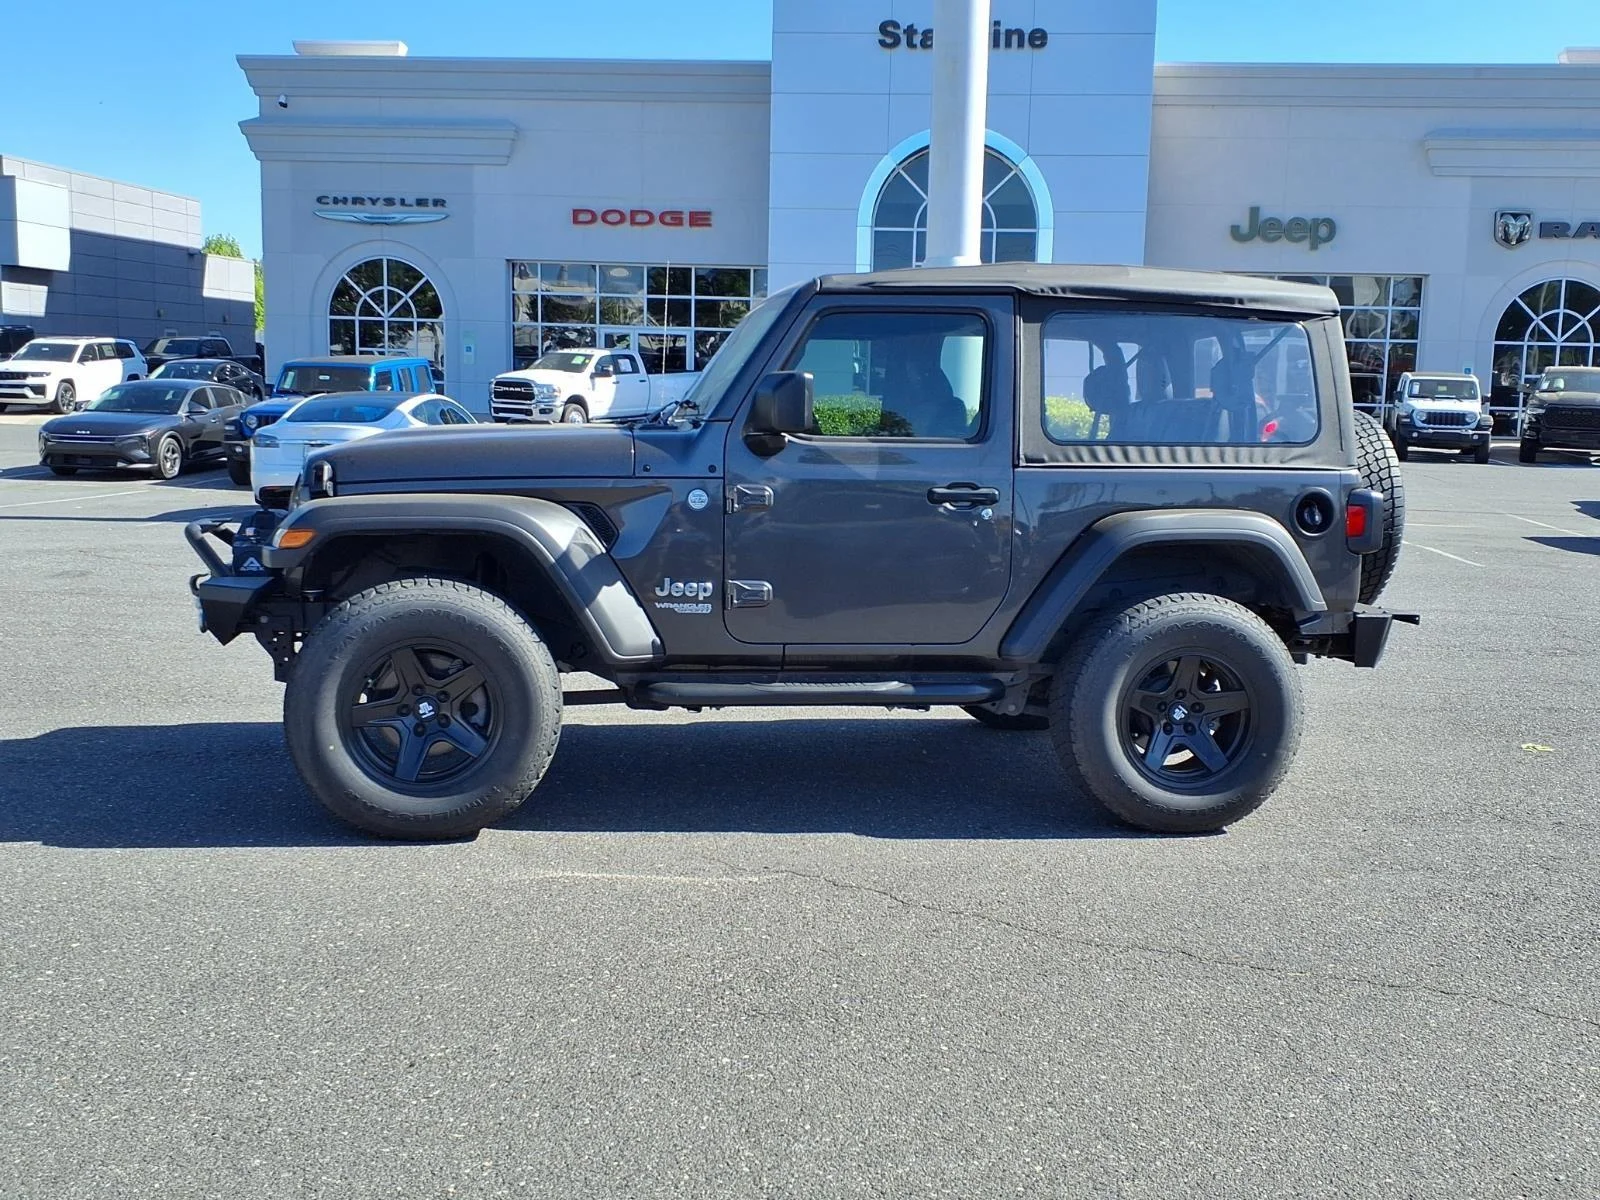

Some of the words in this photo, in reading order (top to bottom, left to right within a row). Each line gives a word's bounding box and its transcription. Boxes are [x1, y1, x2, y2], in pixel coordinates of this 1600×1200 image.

[877, 19, 1048, 49] Staine
[316, 195, 447, 208] CHRYSLER
[572, 208, 712, 228] DODGE
[1230, 206, 1336, 251] Jeep
[1539, 221, 1600, 239] RA
[655, 577, 713, 601] Jeep
